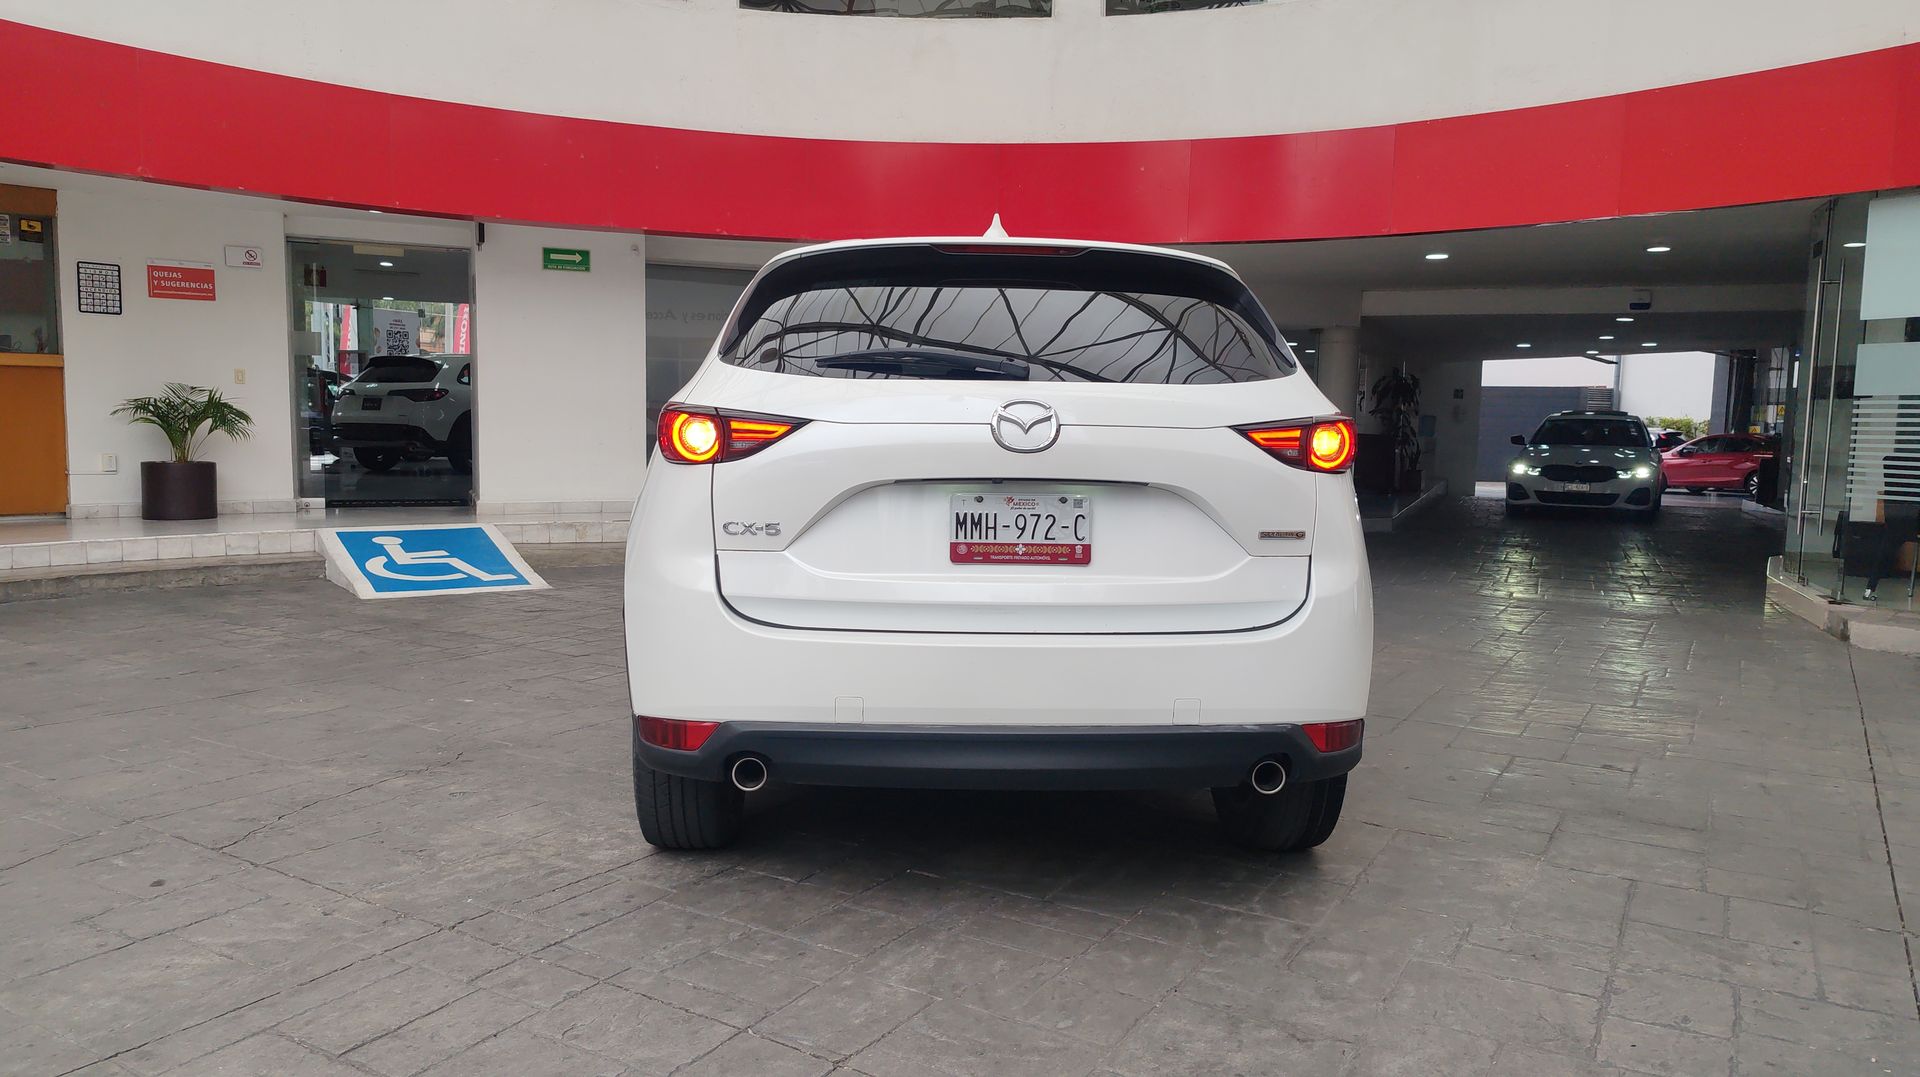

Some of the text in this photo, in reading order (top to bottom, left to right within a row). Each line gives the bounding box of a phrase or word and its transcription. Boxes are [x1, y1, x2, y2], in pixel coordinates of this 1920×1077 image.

[153, 270, 182, 279] QUEJAS
[160, 280, 213, 290] SUGERENCIAS
[722, 521, 782, 536] CX-5
[955, 511, 1086, 541] MMH-972-C
